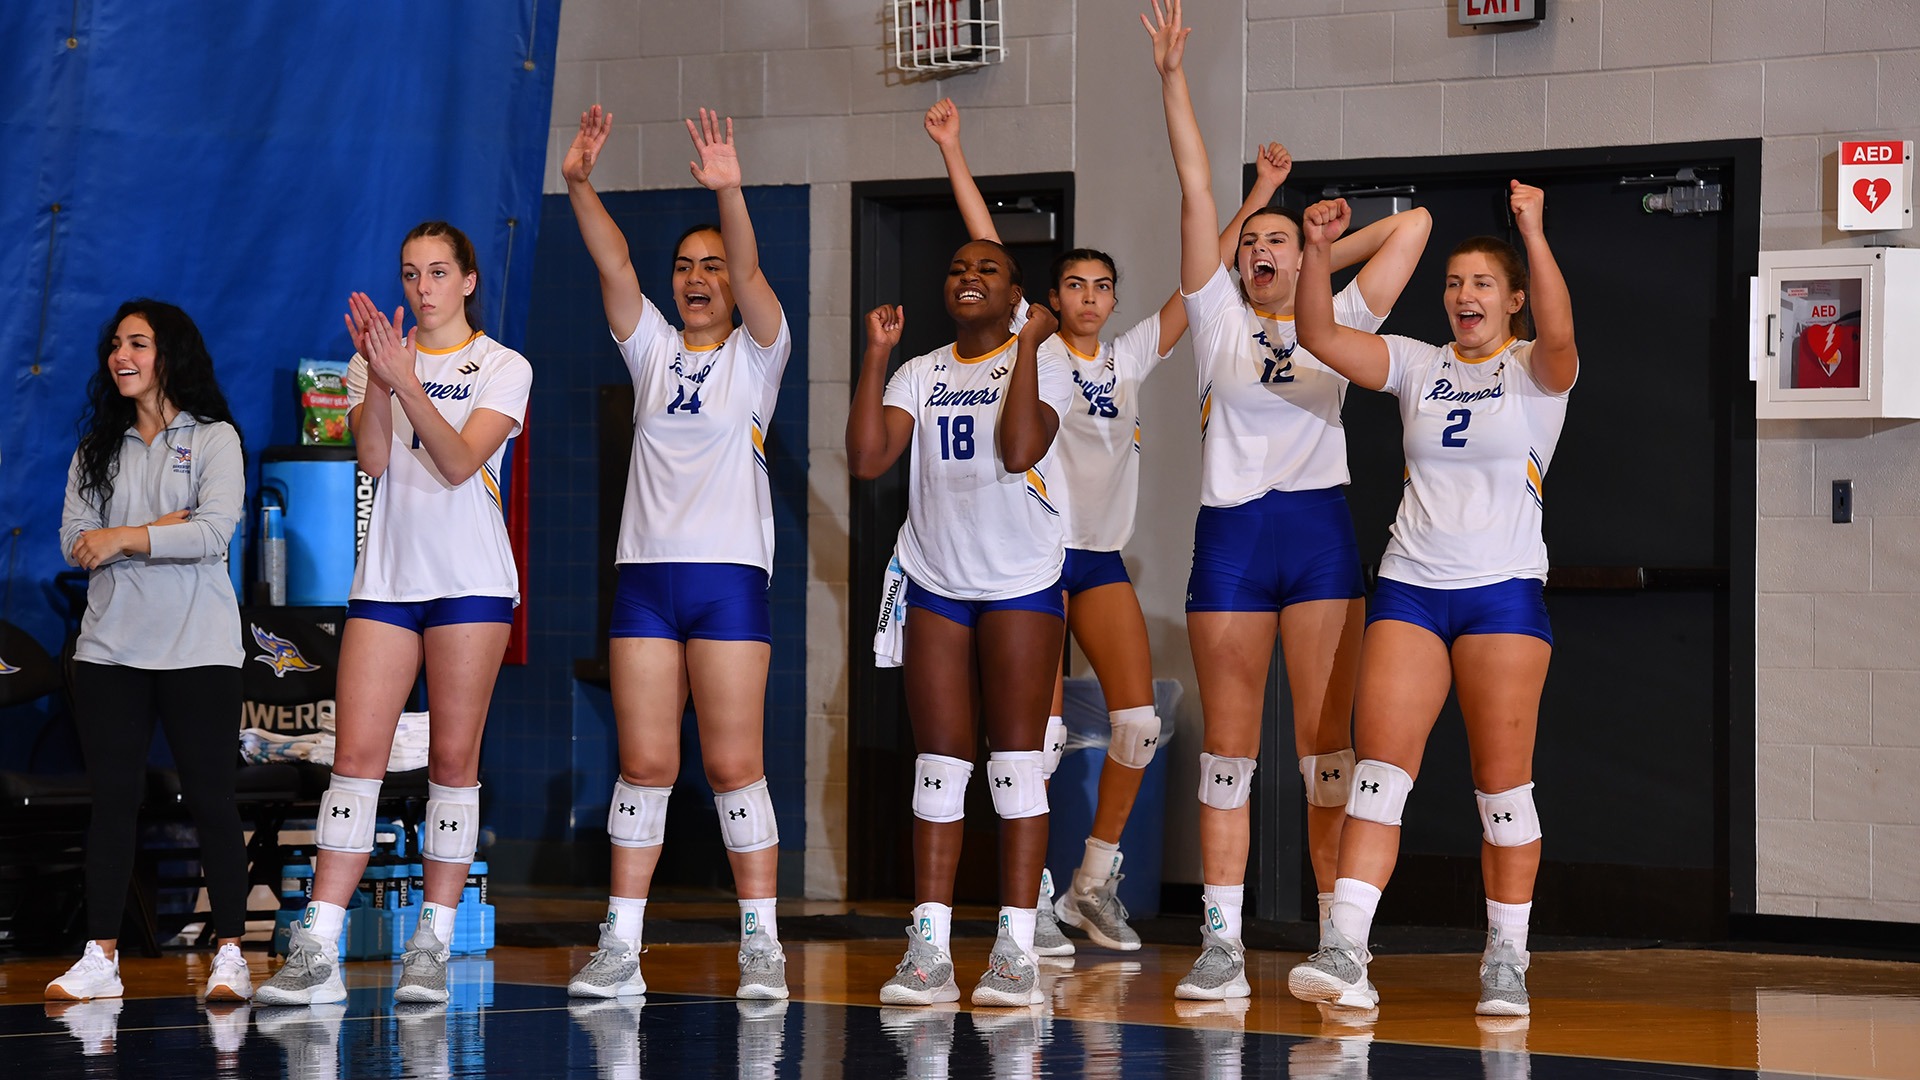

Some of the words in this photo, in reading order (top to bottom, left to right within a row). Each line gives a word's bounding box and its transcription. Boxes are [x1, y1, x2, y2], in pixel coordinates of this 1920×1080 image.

[1853, 146, 1893, 162] AED
[1811, 305, 1837, 318] AED
[1260, 357, 1295, 383] 12
[924, 382, 1000, 408] Runners
[937, 415, 975, 460] 18
[1441, 408, 1472, 448] 2
[877, 578, 901, 634] POWERADE
